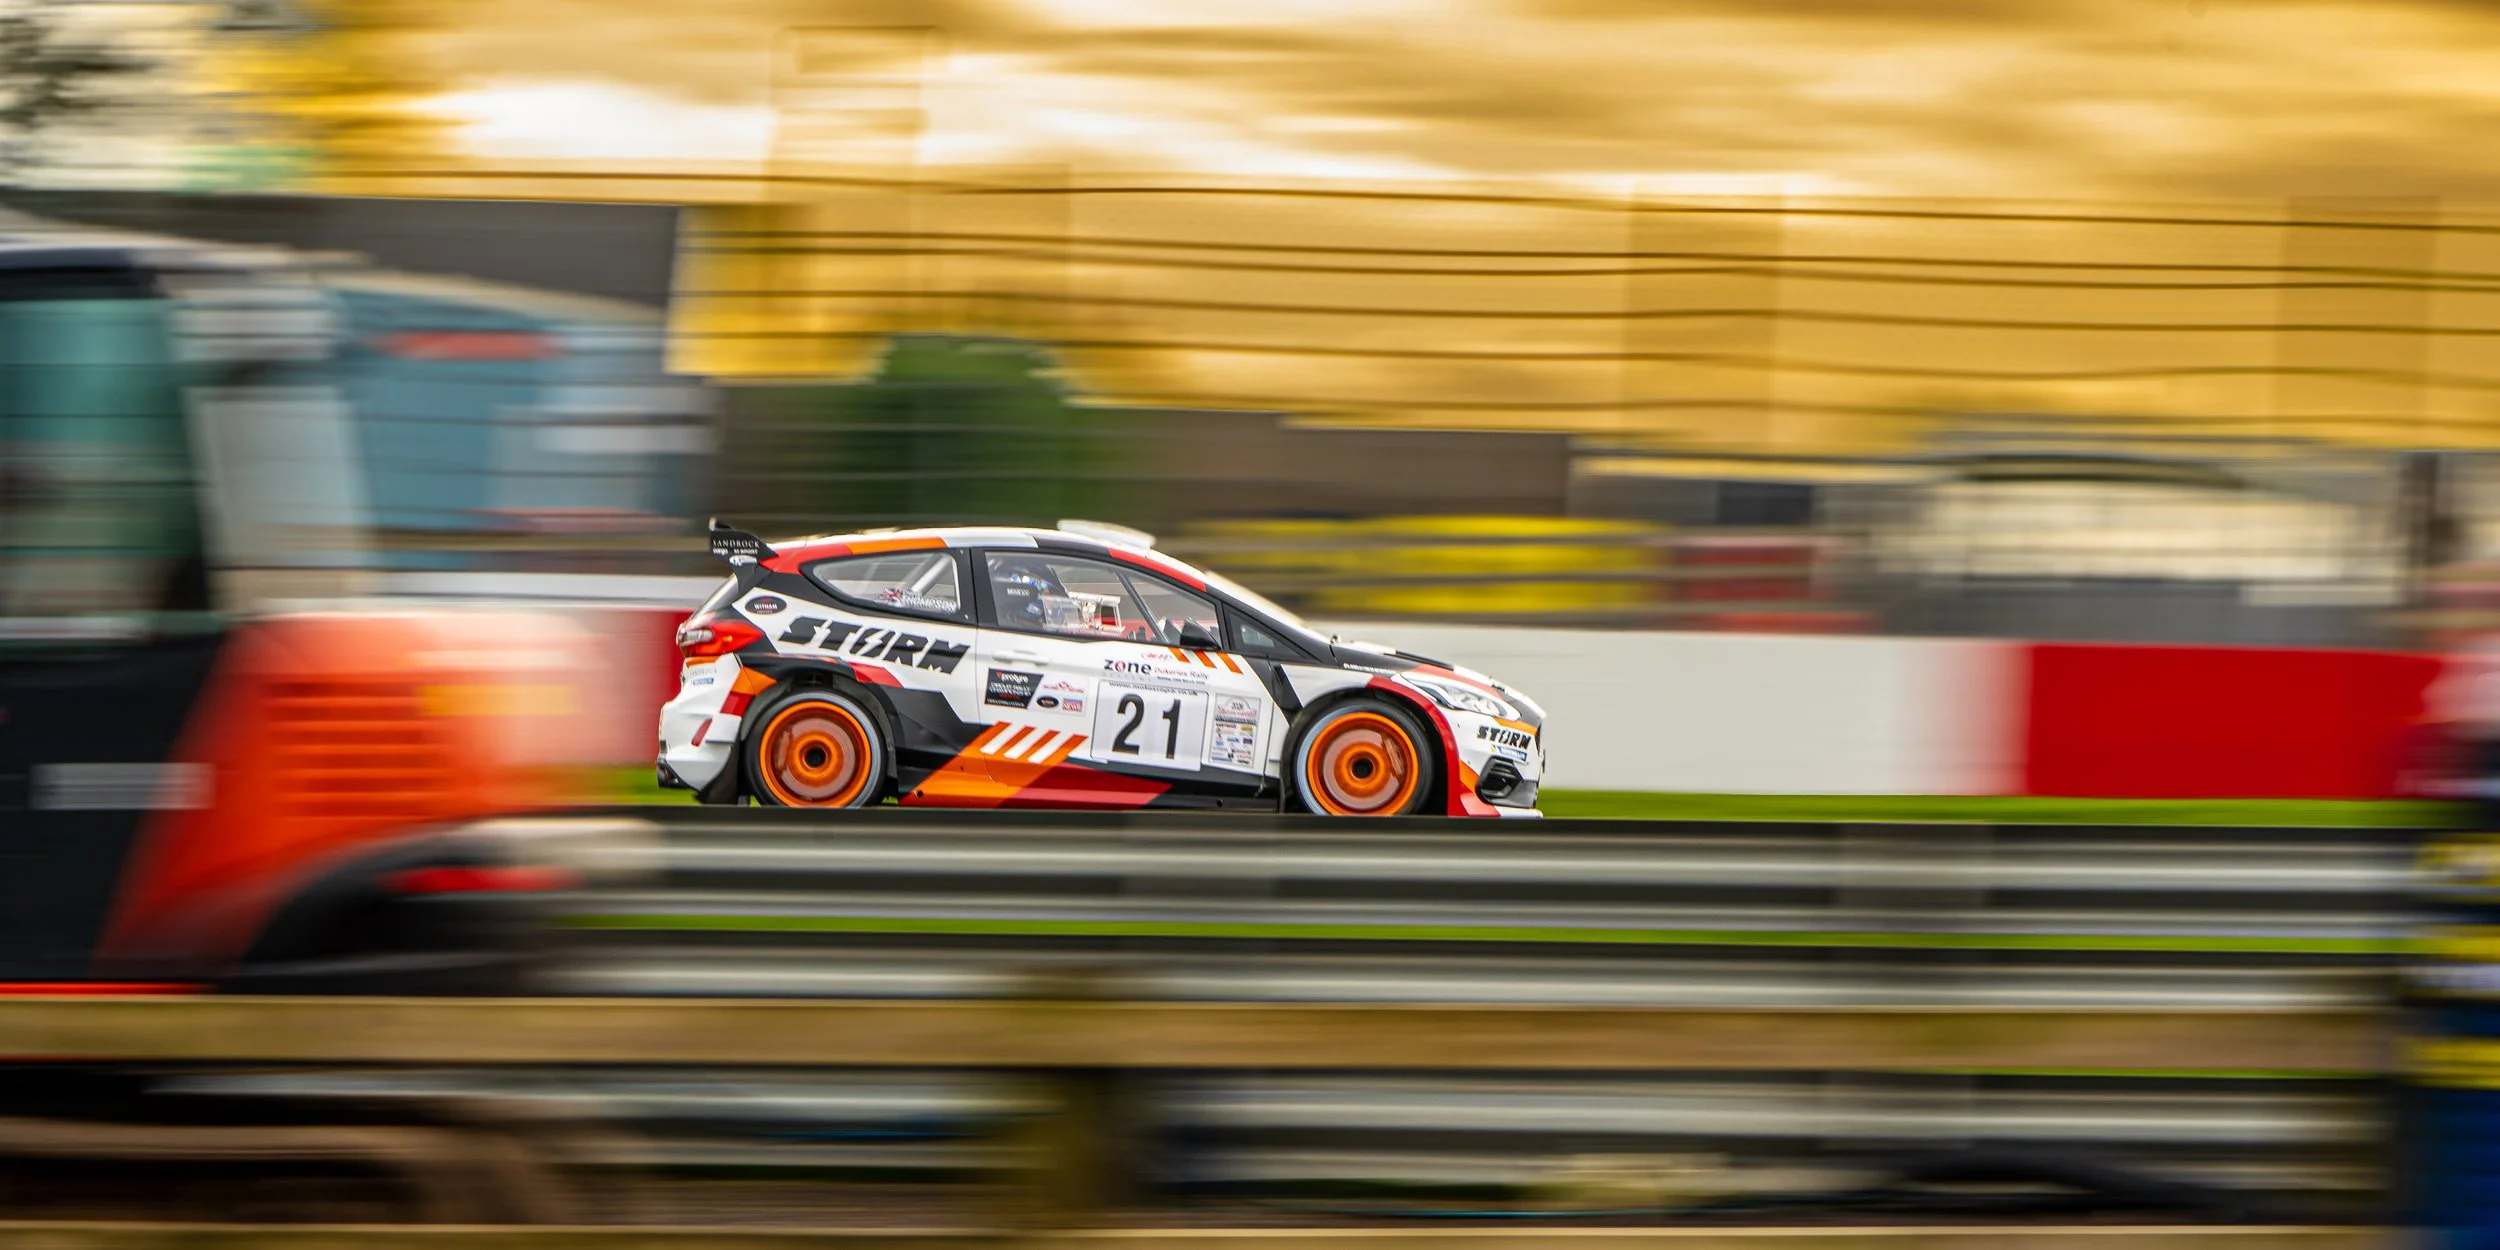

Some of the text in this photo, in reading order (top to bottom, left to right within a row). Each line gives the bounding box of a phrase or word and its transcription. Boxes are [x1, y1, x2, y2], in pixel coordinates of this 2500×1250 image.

[712, 539, 760, 549] SANDROCK
[778, 616, 970, 675] STORM
[1103, 659, 1152, 674] zone
[1112, 693, 1181, 760] 21
[1477, 725, 1531, 750] STORM
